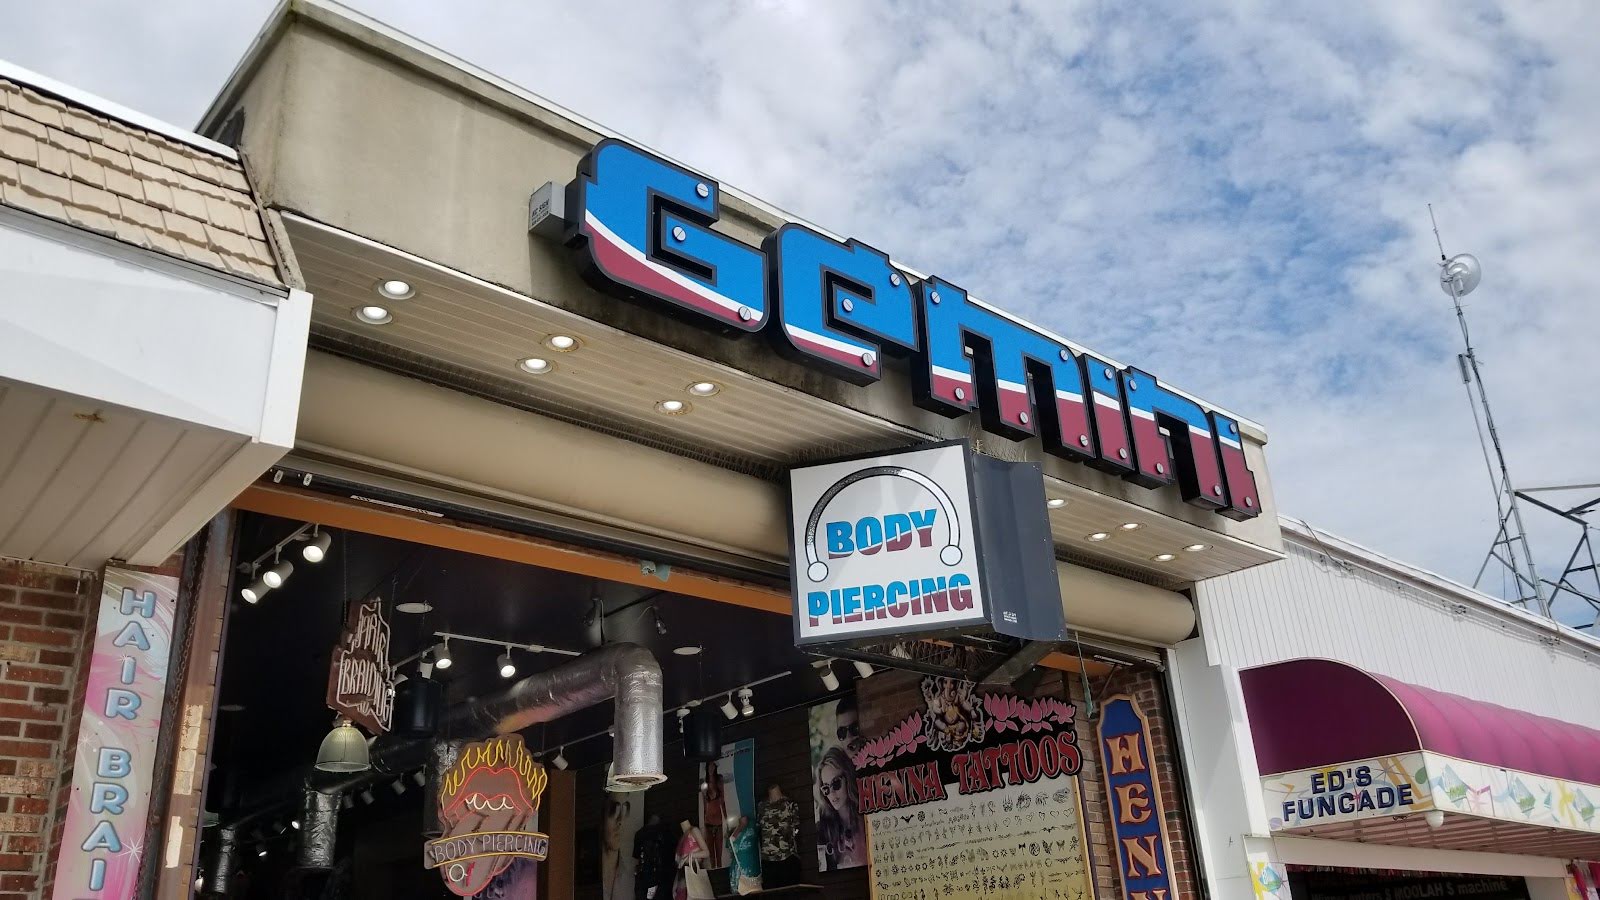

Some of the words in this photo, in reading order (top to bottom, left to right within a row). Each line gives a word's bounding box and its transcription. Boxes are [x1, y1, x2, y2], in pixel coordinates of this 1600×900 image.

[826, 508, 937, 560] BODY
[807, 573, 974, 627] PIERCING
[104, 586, 157, 720] HAIR
[855, 760, 947, 814] HENNA
[951, 731, 1082, 794] TATTOOS
[1310, 765, 1373, 795] ED'S
[81, 747, 132, 900] BRAI
[1105, 732, 1168, 900] HEN
[1282, 783, 1414, 822] FUNCADE
[434, 839, 477, 864] BODY
[481, 834, 547, 856] PIERCING
[1394, 882, 1444, 900] MOOLAH
[1457, 879, 1509, 895] machine
